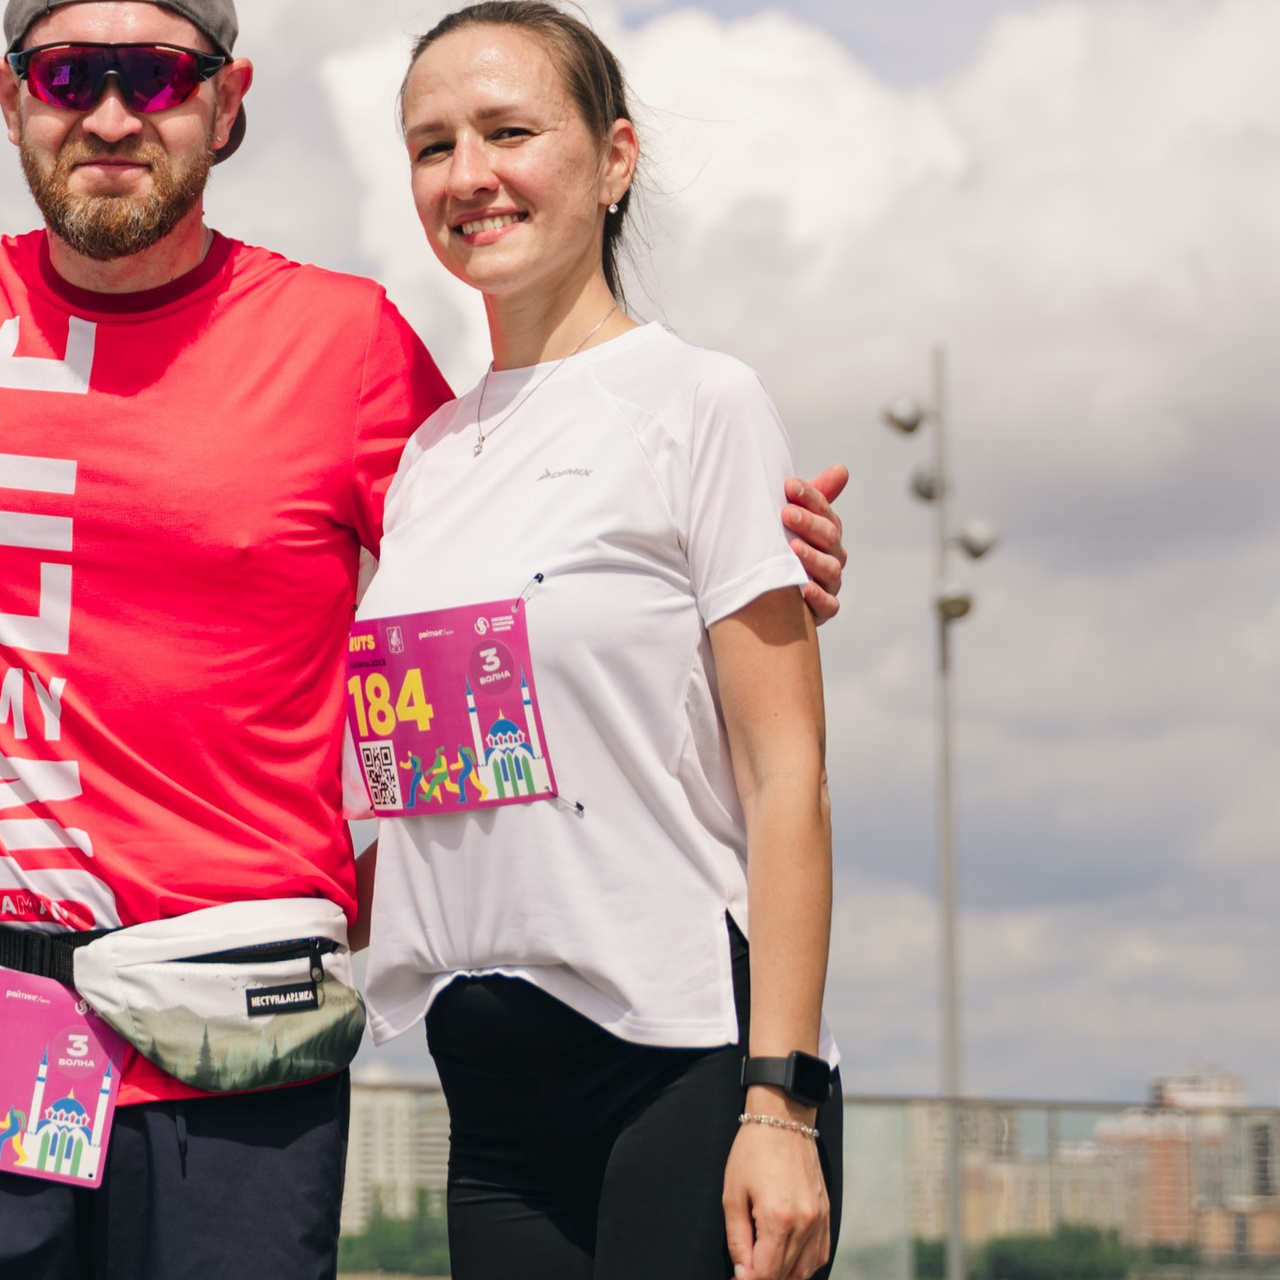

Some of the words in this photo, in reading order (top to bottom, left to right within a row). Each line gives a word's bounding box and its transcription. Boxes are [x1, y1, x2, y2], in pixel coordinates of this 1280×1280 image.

[348, 634, 376, 653] RUTS
[479, 647, 501, 672] 3
[479, 670, 511, 685] ВОЛНА
[347, 668, 434, 738] 184
[66, 1034, 89, 1057] 3
[58, 1057, 95, 1068] ВОЛНА
